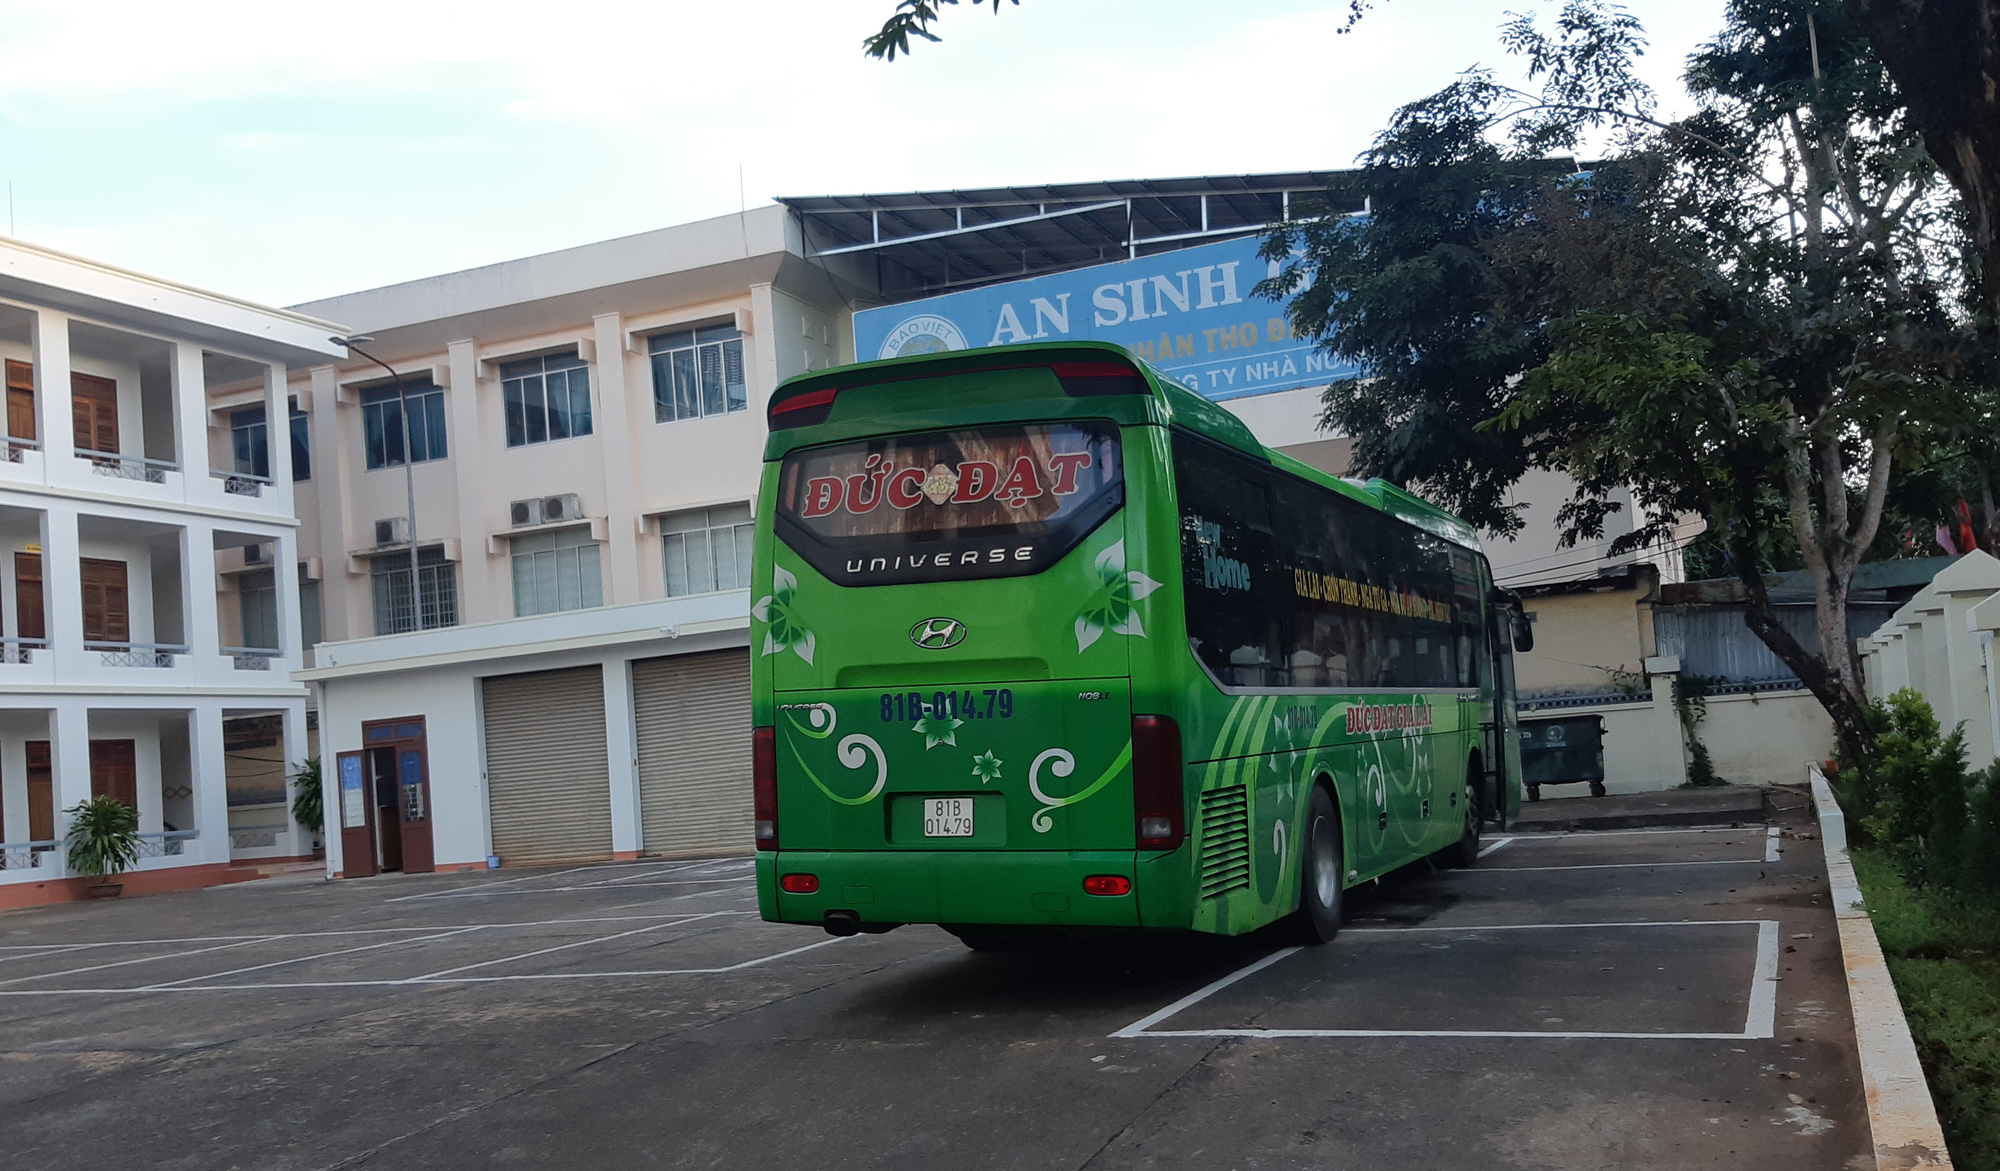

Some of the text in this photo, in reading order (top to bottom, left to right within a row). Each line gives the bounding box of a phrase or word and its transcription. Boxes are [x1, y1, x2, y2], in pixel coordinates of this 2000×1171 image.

[988, 294, 1071, 346] AN
[1093, 260, 1243, 327] SINH
[1202, 322, 1258, 352] THỌ
[1206, 367, 1237, 388] TY
[1245, 354, 1298, 382] NHÀ
[801, 451, 1092, 518] ĐỨC ĐẠT
[846, 546, 1034, 574] UNIVERSE
[880, 689, 1014, 723] 81B-014.79
[1078, 691, 1111, 700] NOBLE
[1346, 697, 1372, 735] ĐỨC
[1372, 703, 1395, 739] ĐẠT
[925, 800, 971, 835] 81B 014.79
